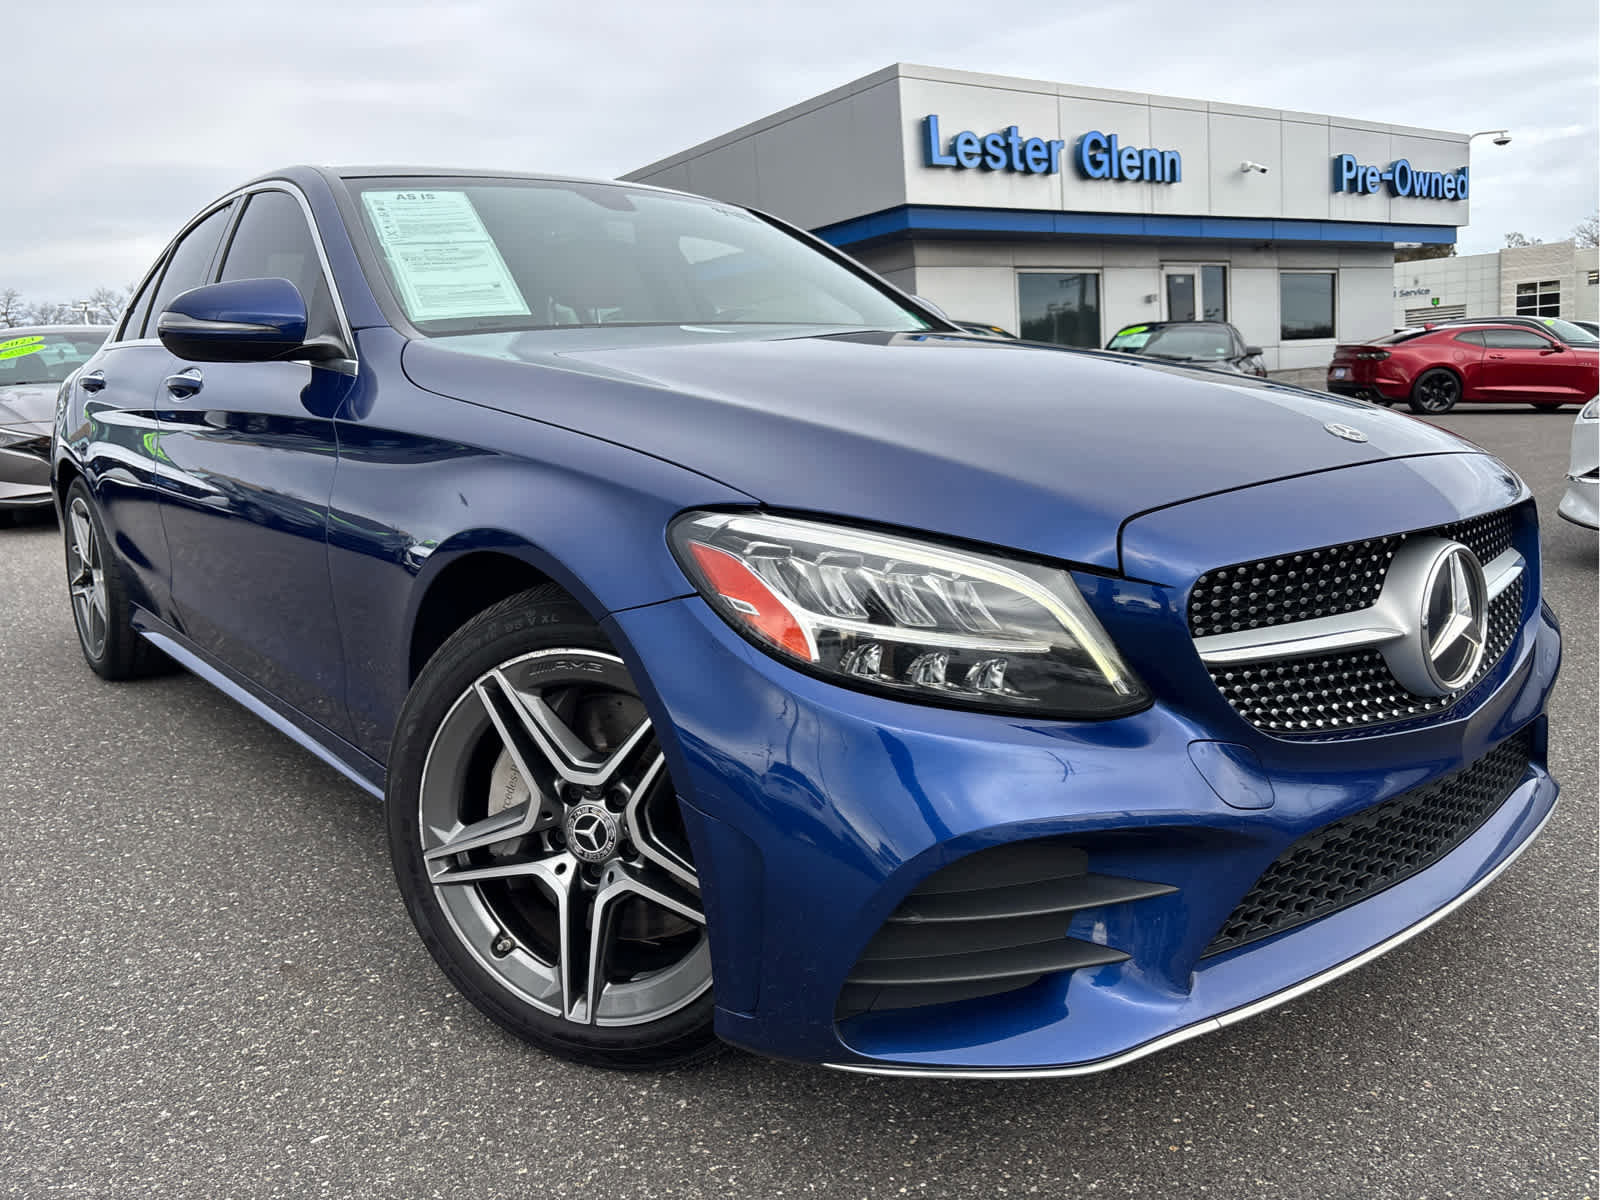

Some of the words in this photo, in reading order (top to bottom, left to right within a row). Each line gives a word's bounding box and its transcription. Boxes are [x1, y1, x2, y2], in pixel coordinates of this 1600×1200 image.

[922, 114, 1064, 175] Lester
[1075, 130, 1182, 183] Glenn
[1334, 153, 1468, 200] Pre-Owned
[396, 192, 417, 201] AS
[420, 192, 437, 201] IS
[1399, 288, 1431, 297] Service
